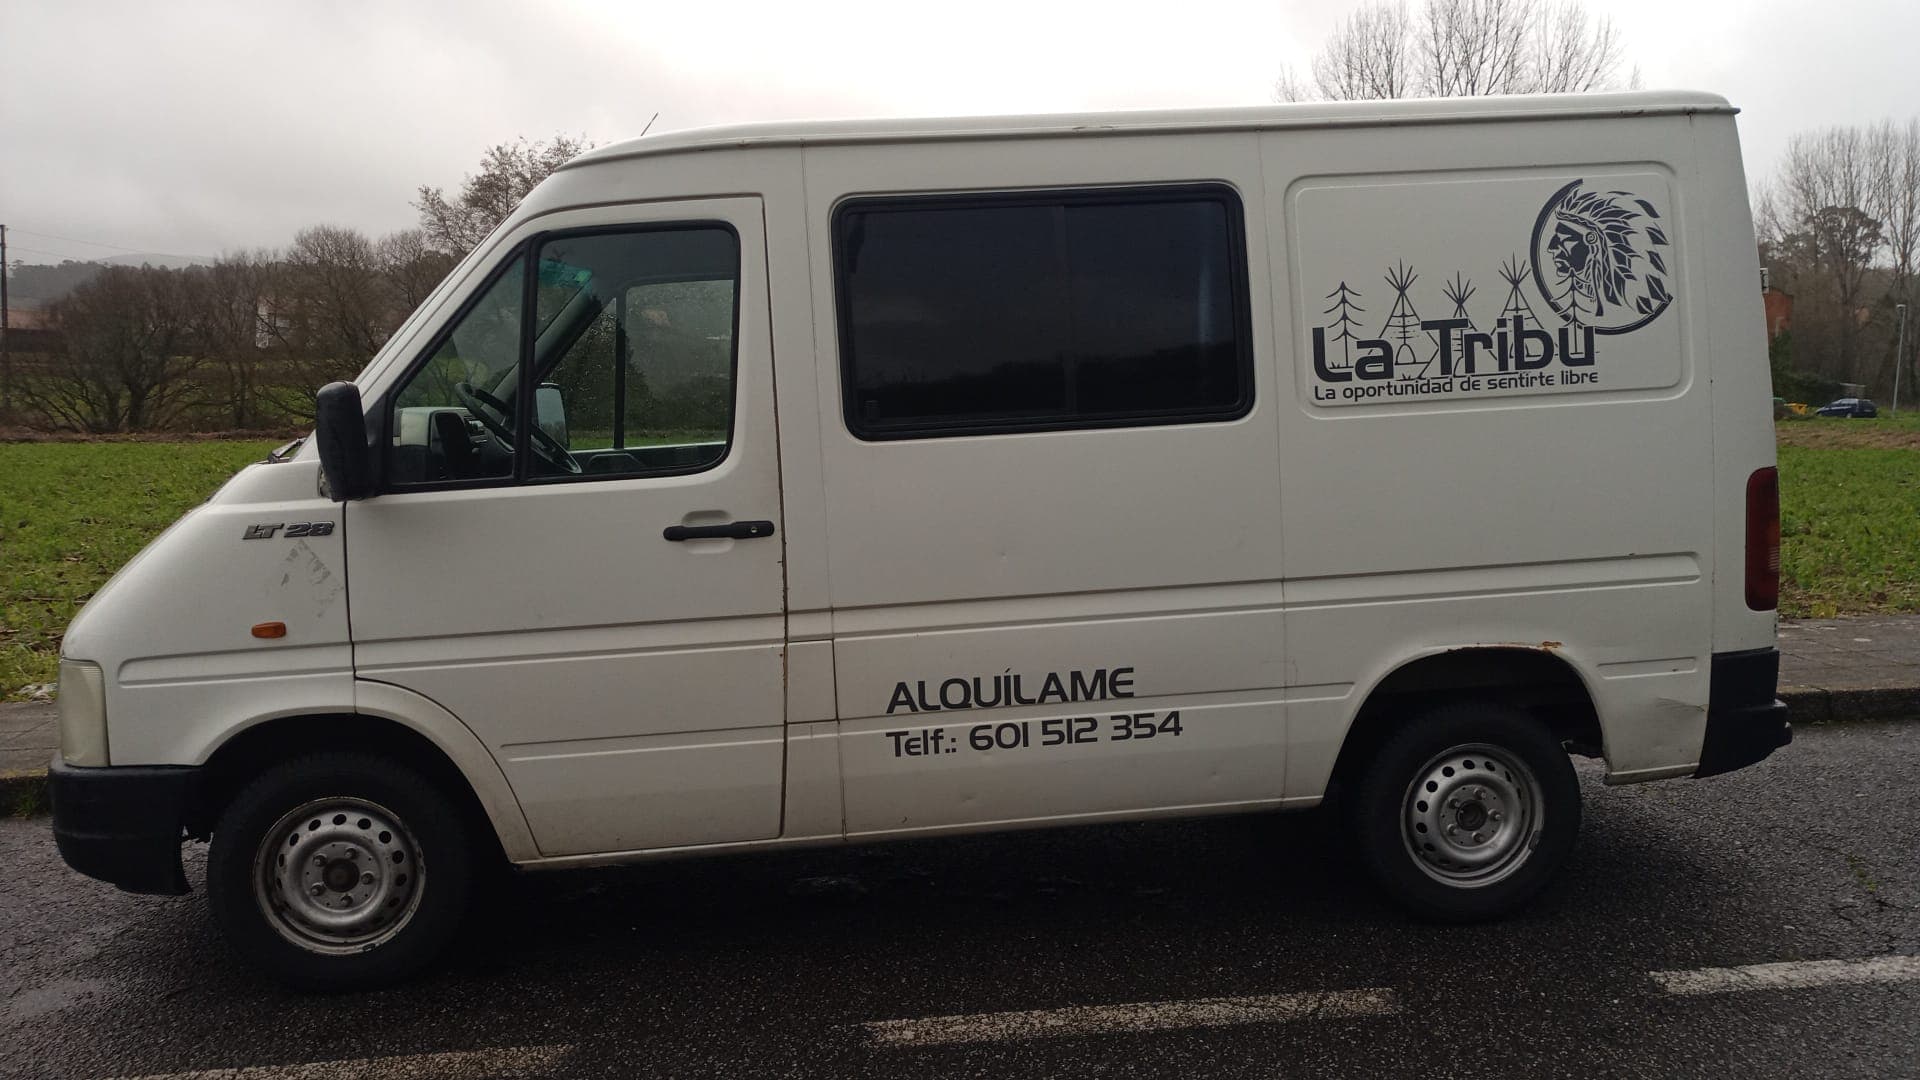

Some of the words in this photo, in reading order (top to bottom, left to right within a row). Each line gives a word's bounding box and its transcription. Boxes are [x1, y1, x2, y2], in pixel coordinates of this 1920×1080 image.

[1312, 326, 1395, 383] La
[1420, 314, 1596, 377] Tribu
[1314, 385, 1336, 401] La
[1343, 377, 1453, 402] oportunidad
[1460, 374, 1481, 392] de
[1487, 372, 1555, 390] sentirte
[1560, 370, 1599, 386] libre
[242, 523, 285, 540] LT
[284, 521, 335, 538] 28
[886, 667, 1134, 714] ALQUÍLAME
[886, 728, 957, 758] Telf.:
[969, 721, 1029, 750] 601
[1041, 717, 1098, 747] 512
[1110, 710, 1183, 741] 354
